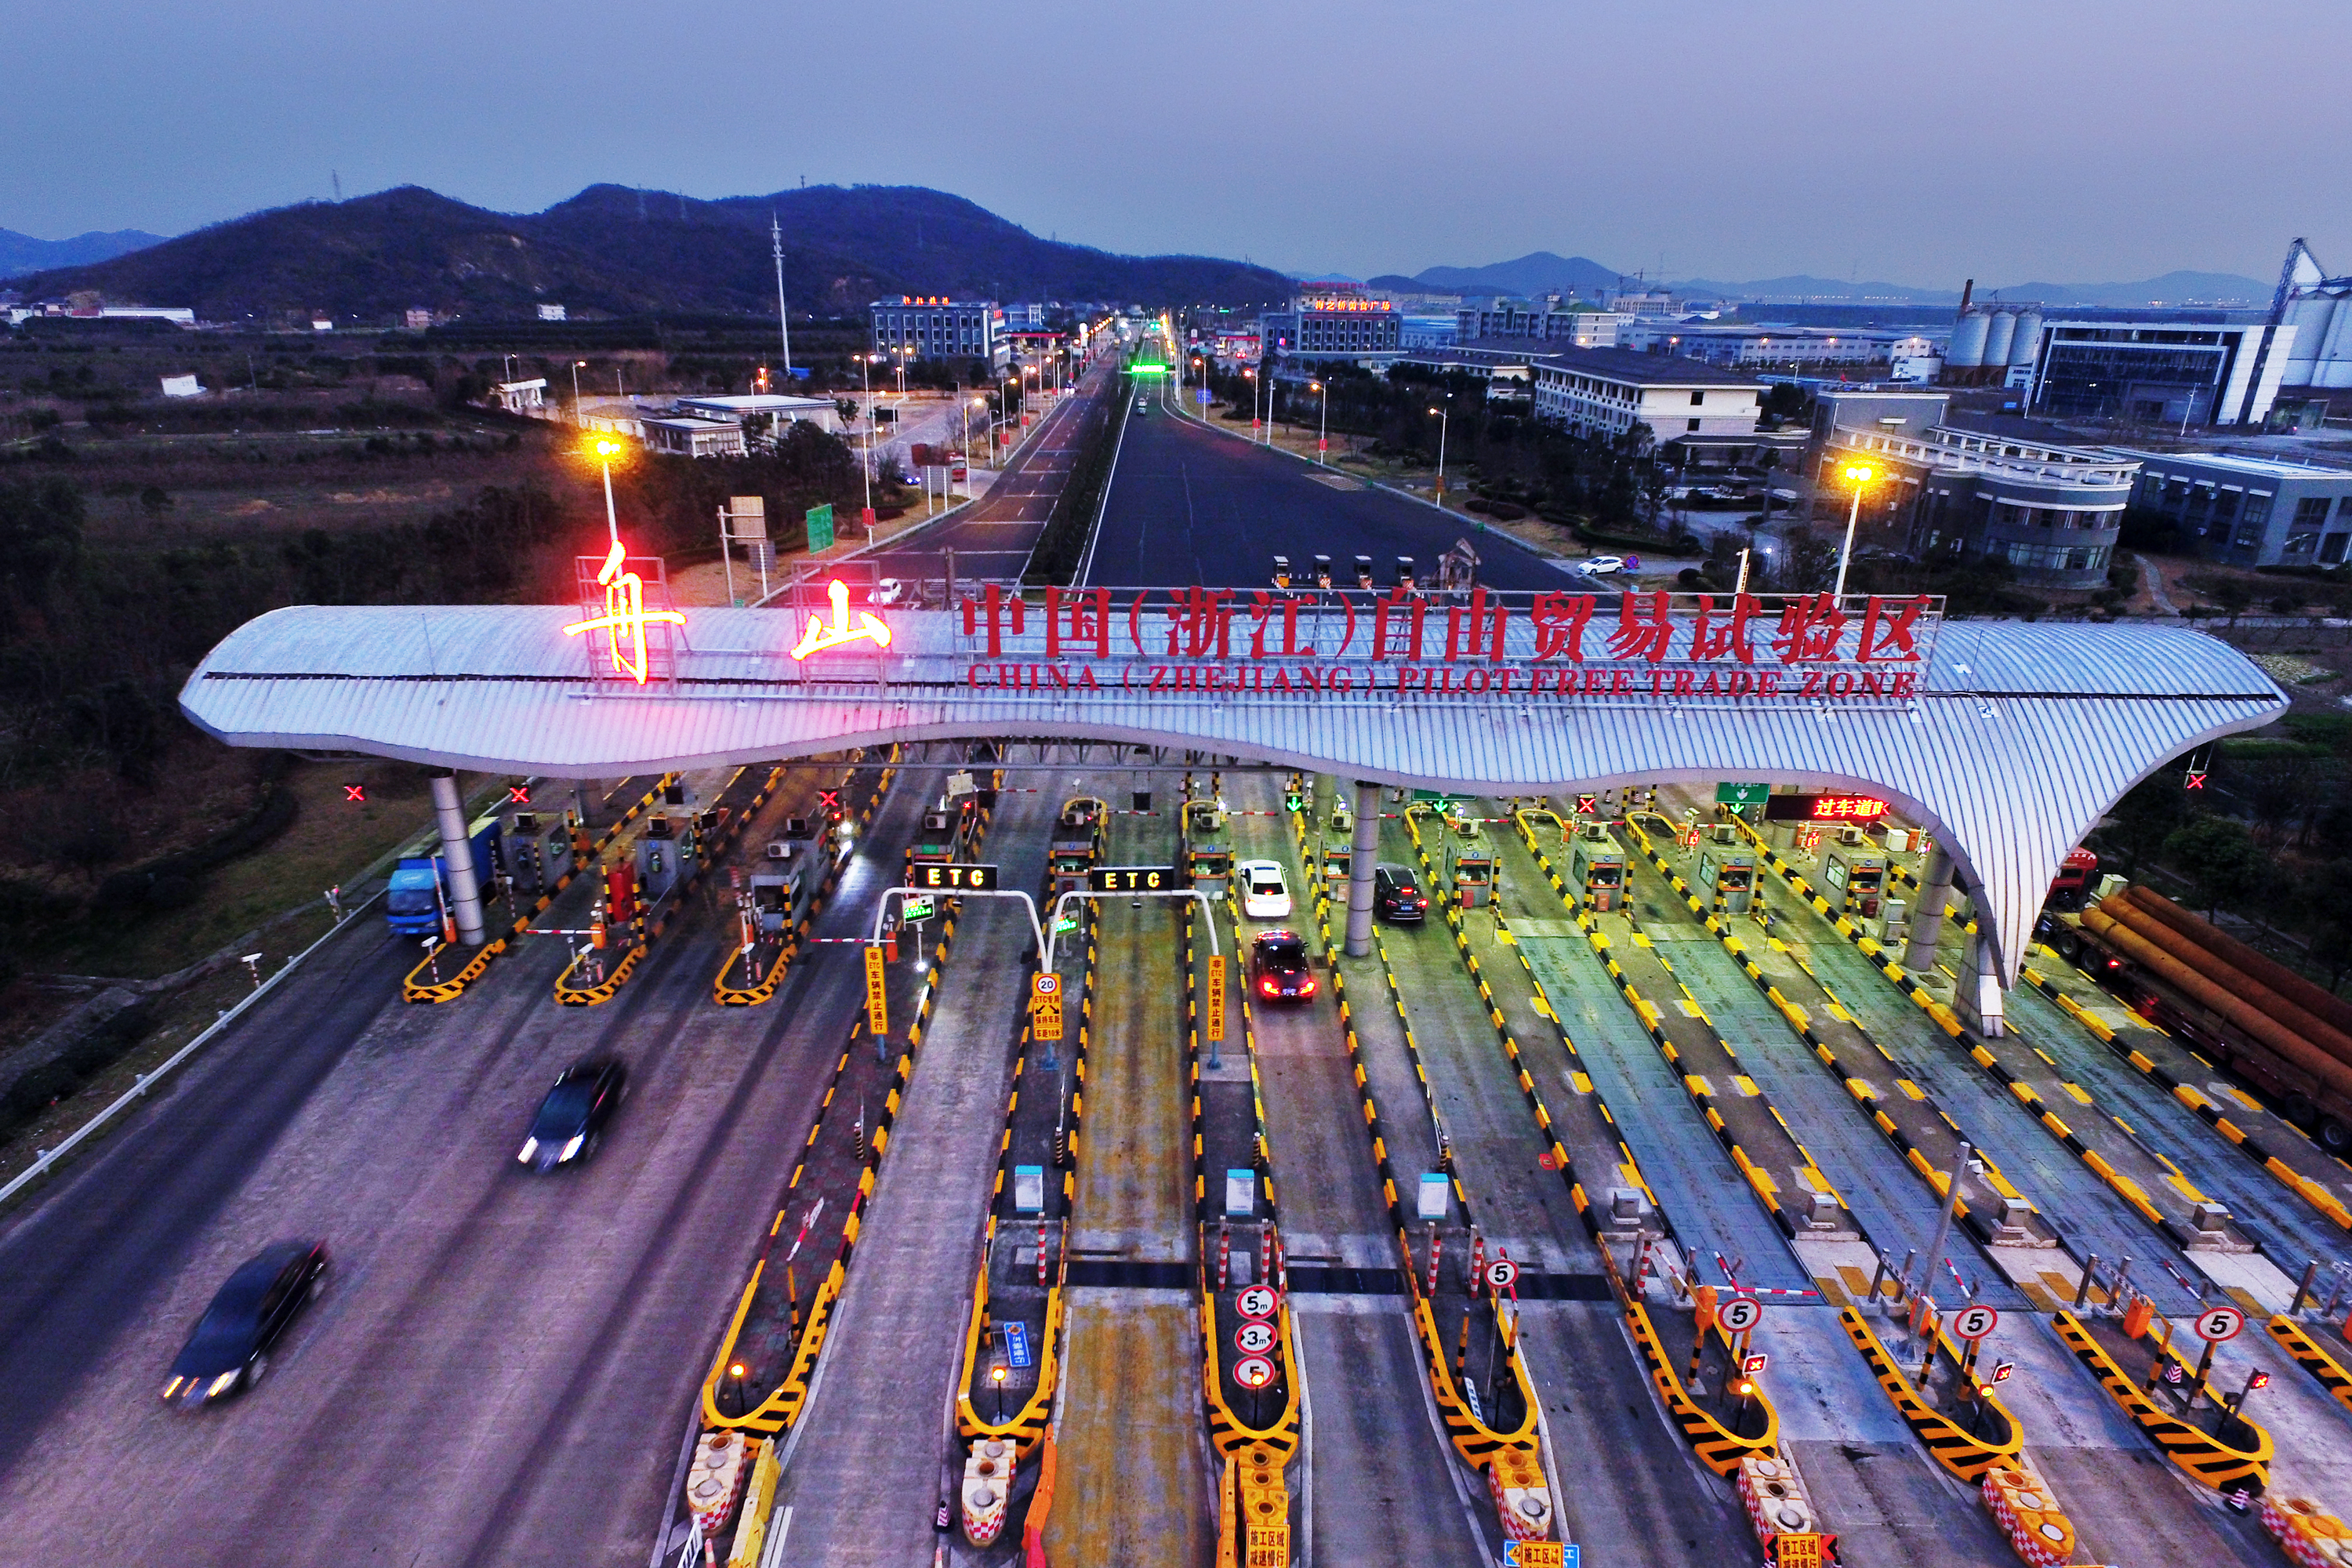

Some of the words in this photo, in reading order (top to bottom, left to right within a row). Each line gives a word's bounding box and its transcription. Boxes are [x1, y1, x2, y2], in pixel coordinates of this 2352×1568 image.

[562, 539, 892, 685] 舟山
[962, 583, 1933, 666] 中国(浙江)自由贸易试验区
[967, 663, 1102, 691] CHINA
[1398, 667, 1519, 695] PILOT
[1530, 668, 1635, 696] FREE
[1648, 669, 1783, 698] TRADE
[1800, 671, 1918, 699] ZONE
[927, 868, 984, 887] ETC
[1105, 872, 1160, 889] ETC
[869, 951, 883, 1030] 非ETC车辆禁止通行
[1035, 995, 1060, 1004] ETC专用
[1210, 960, 1221, 1037] 非ETC车辆禁止通行
[1036, 1015, 1060, 1025] 保持车距
[1036, 1029, 1061, 1038] 车距10米
[1494, 1265, 1508, 1283] 5
[1247, 1295, 1268, 1311] 5m
[1731, 1305, 1748, 1324] 5
[1966, 1312, 1984, 1332] 5
[2209, 1315, 2229, 1334] 5
[1247, 1330, 1267, 1345] 3m
[1250, 1530, 1285, 1548] 施工区域
[1782, 1538, 1817, 1556] 施工区域
[1250, 1549, 1285, 1567] 减速慢行
[1524, 1546, 1559, 1565] 施工区域
